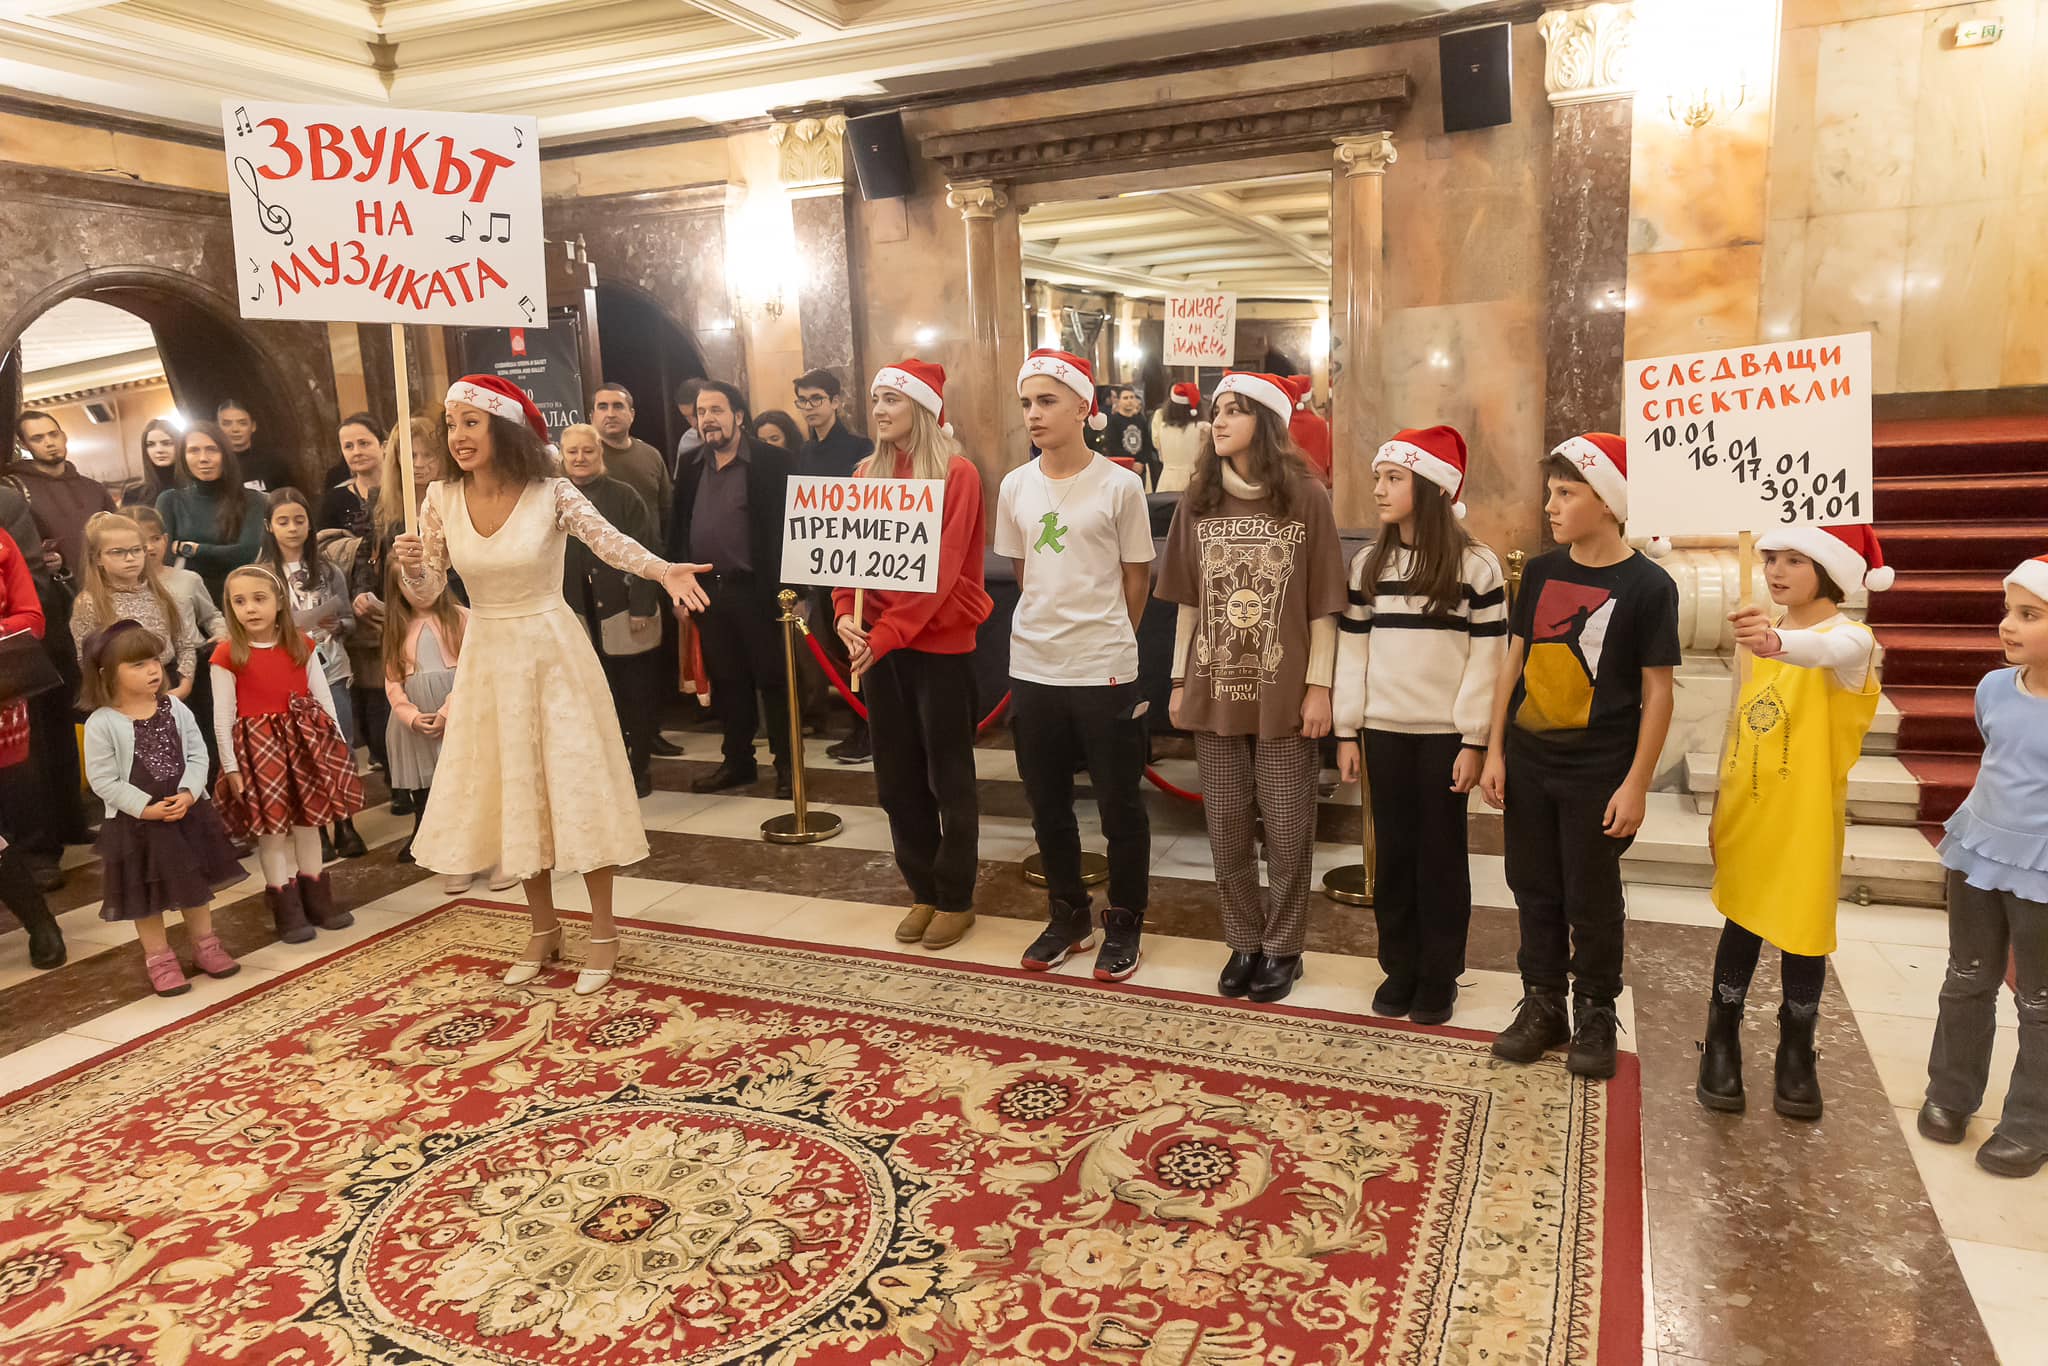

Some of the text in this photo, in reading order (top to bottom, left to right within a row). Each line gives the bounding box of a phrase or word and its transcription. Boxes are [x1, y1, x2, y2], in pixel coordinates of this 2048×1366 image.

[256, 118, 516, 203] ЗВУКЪТ
[356, 200, 414, 236] НА
[271, 240, 508, 310] МУЗИКАТА
[1640, 345, 1841, 390] СЛЕДВАЩИ
[1642, 375, 1851, 421] СПЕКТАКЛИ
[1645, 420, 1715, 451] 10.01
[1688, 436, 1758, 471] 16.01
[1732, 451, 1810, 483] 17.01
[793, 483, 934, 512] МЮЗИКЪЛ
[1760, 468, 1846, 501] 30.01
[1780, 491, 1860, 523] 31.01
[789, 516, 929, 544] ПРЕМИЕРА
[1198, 519, 1306, 543] ETHEREAL
[810, 547, 926, 582] 9.01.2024
